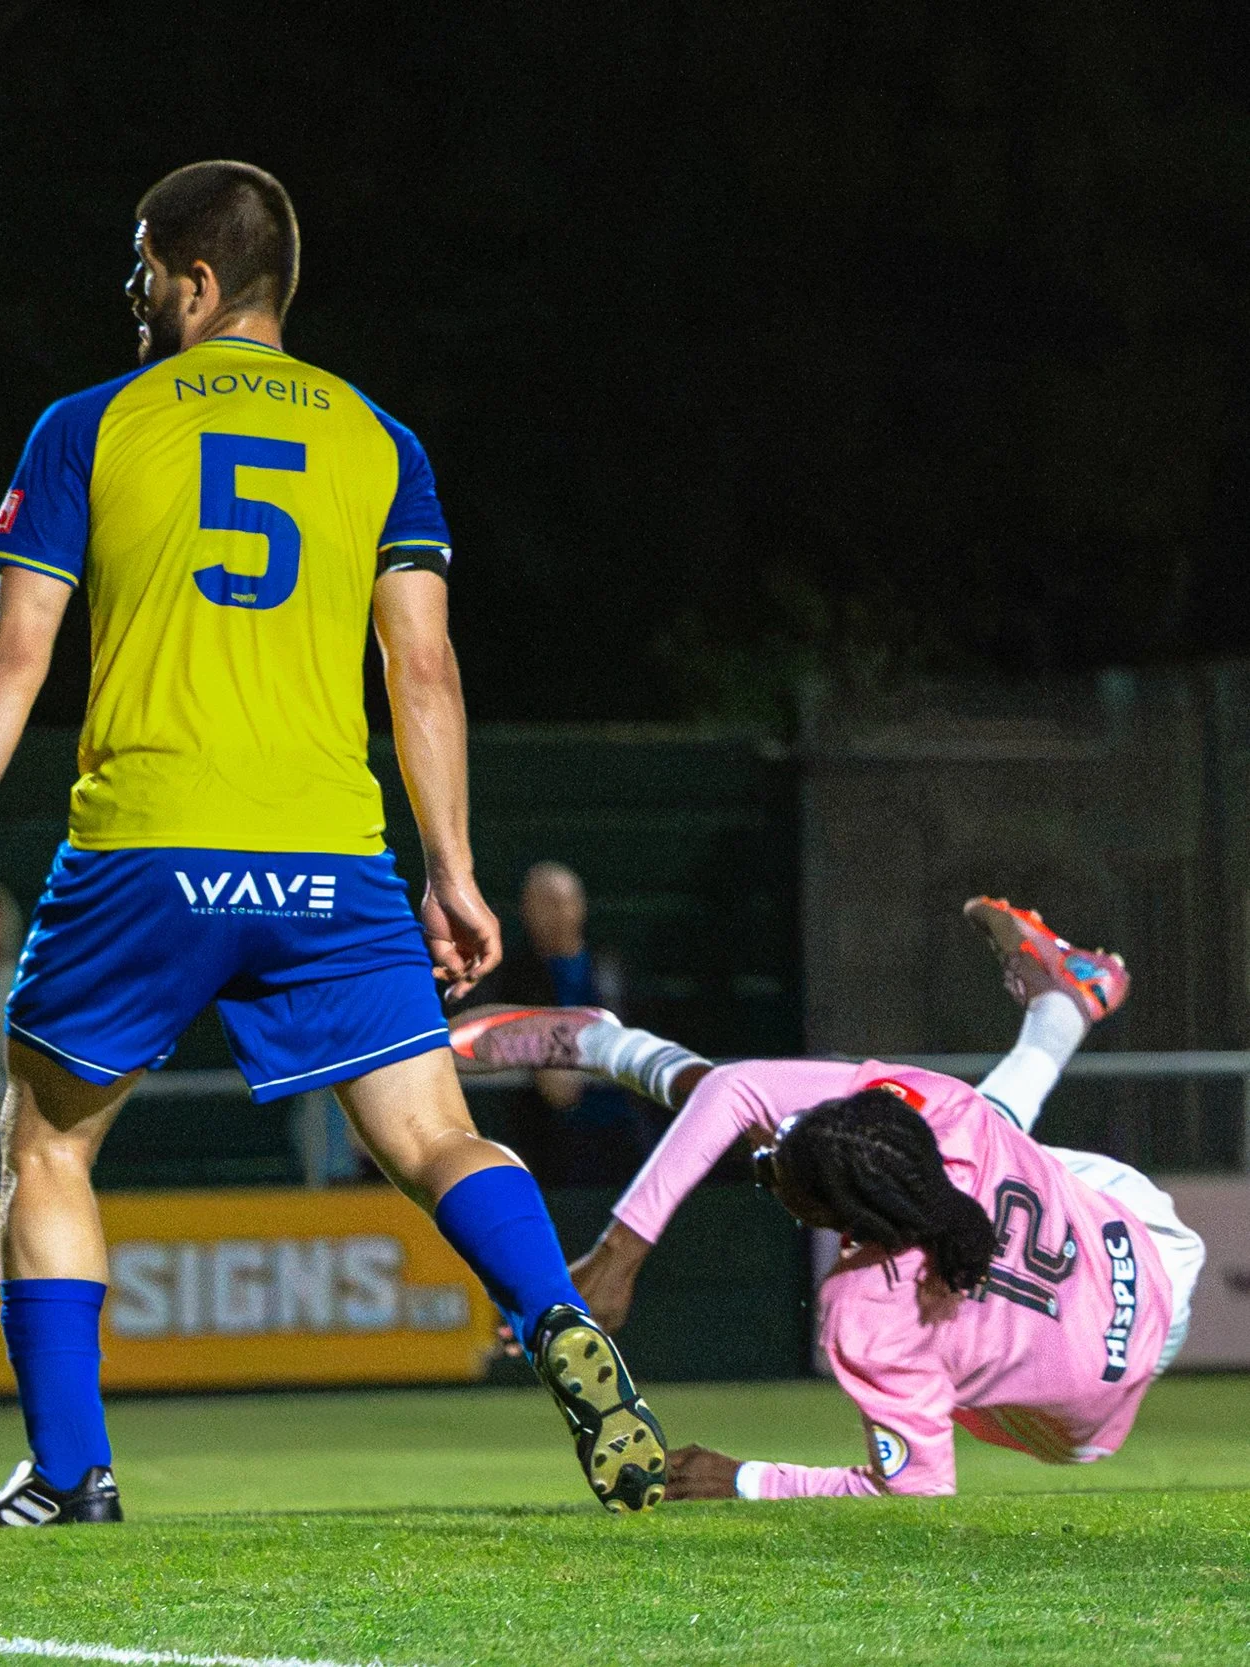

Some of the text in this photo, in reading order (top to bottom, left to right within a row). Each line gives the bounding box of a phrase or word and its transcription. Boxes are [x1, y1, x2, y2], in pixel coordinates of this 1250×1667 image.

[174, 373, 331, 410] Novelis
[193, 432, 306, 609] 5
[174, 871, 336, 908] WAVE
[111, 1236, 402, 1337] SIGNS
